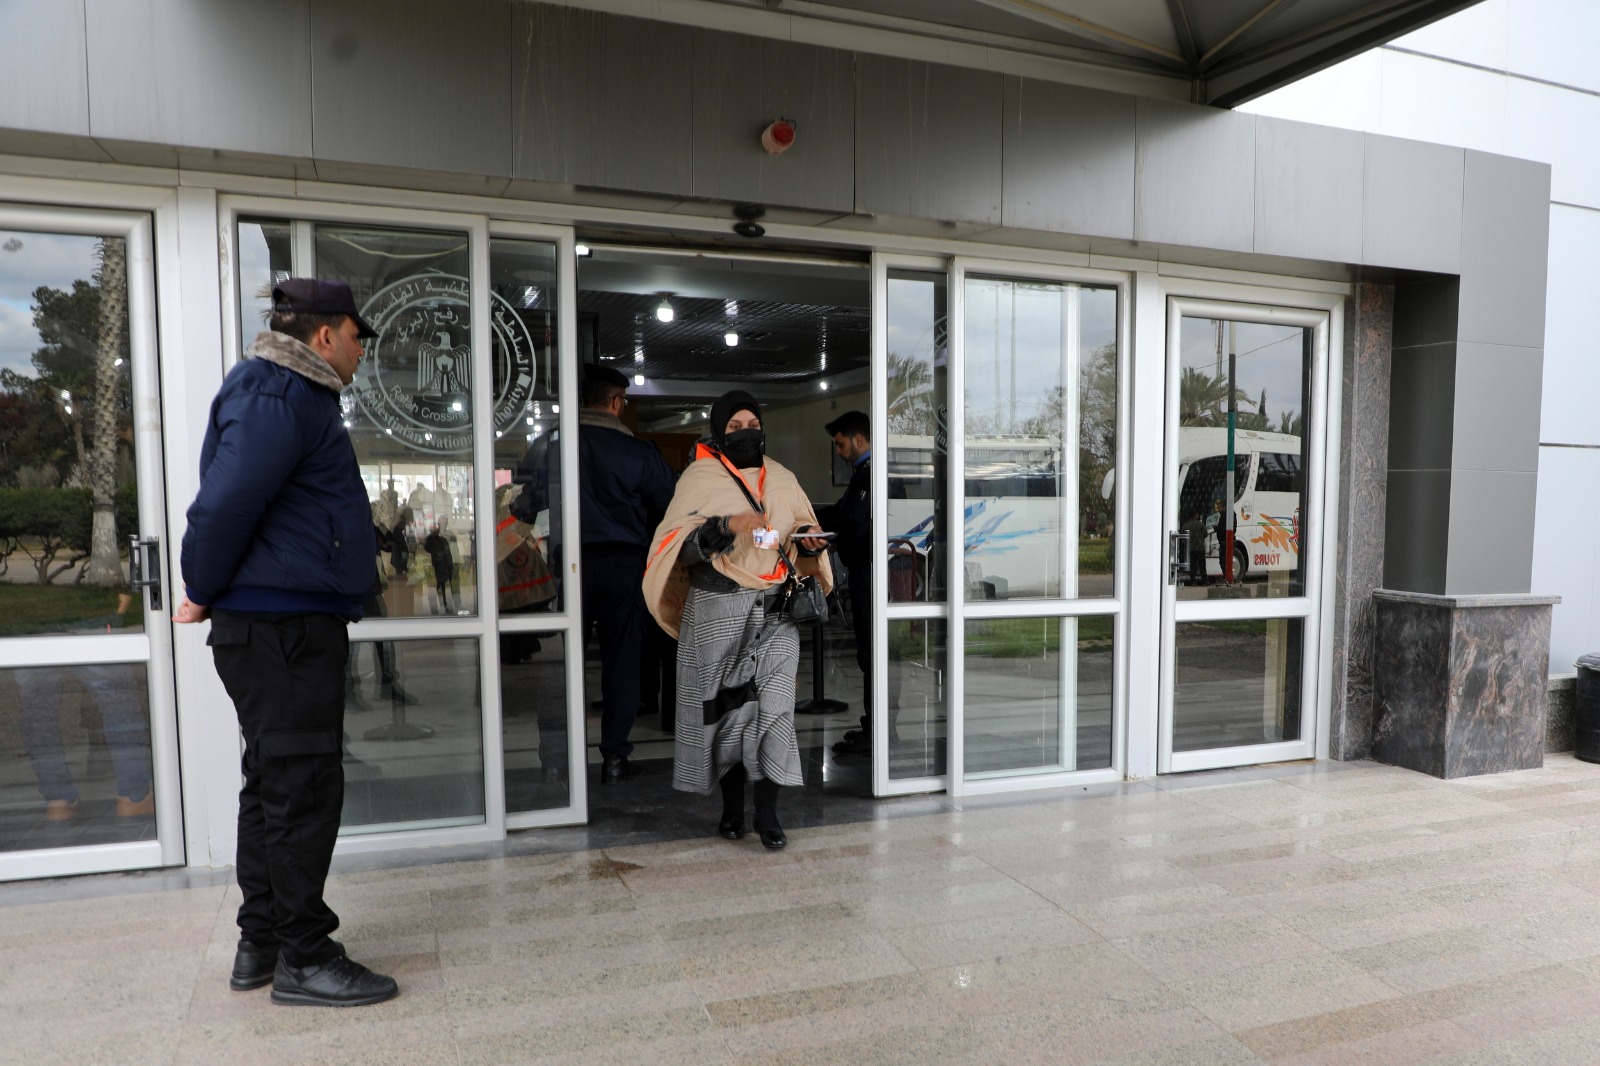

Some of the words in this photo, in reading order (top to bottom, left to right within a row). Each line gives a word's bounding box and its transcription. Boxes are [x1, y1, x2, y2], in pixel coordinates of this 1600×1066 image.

[433, 307, 459, 326] رفح
[495, 305, 529, 371] السلطة
[391, 385, 418, 413] Rafah
[421, 407, 469, 422] Crossing
[425, 433, 473, 449] Nationa
[494, 384, 525, 429] thority
